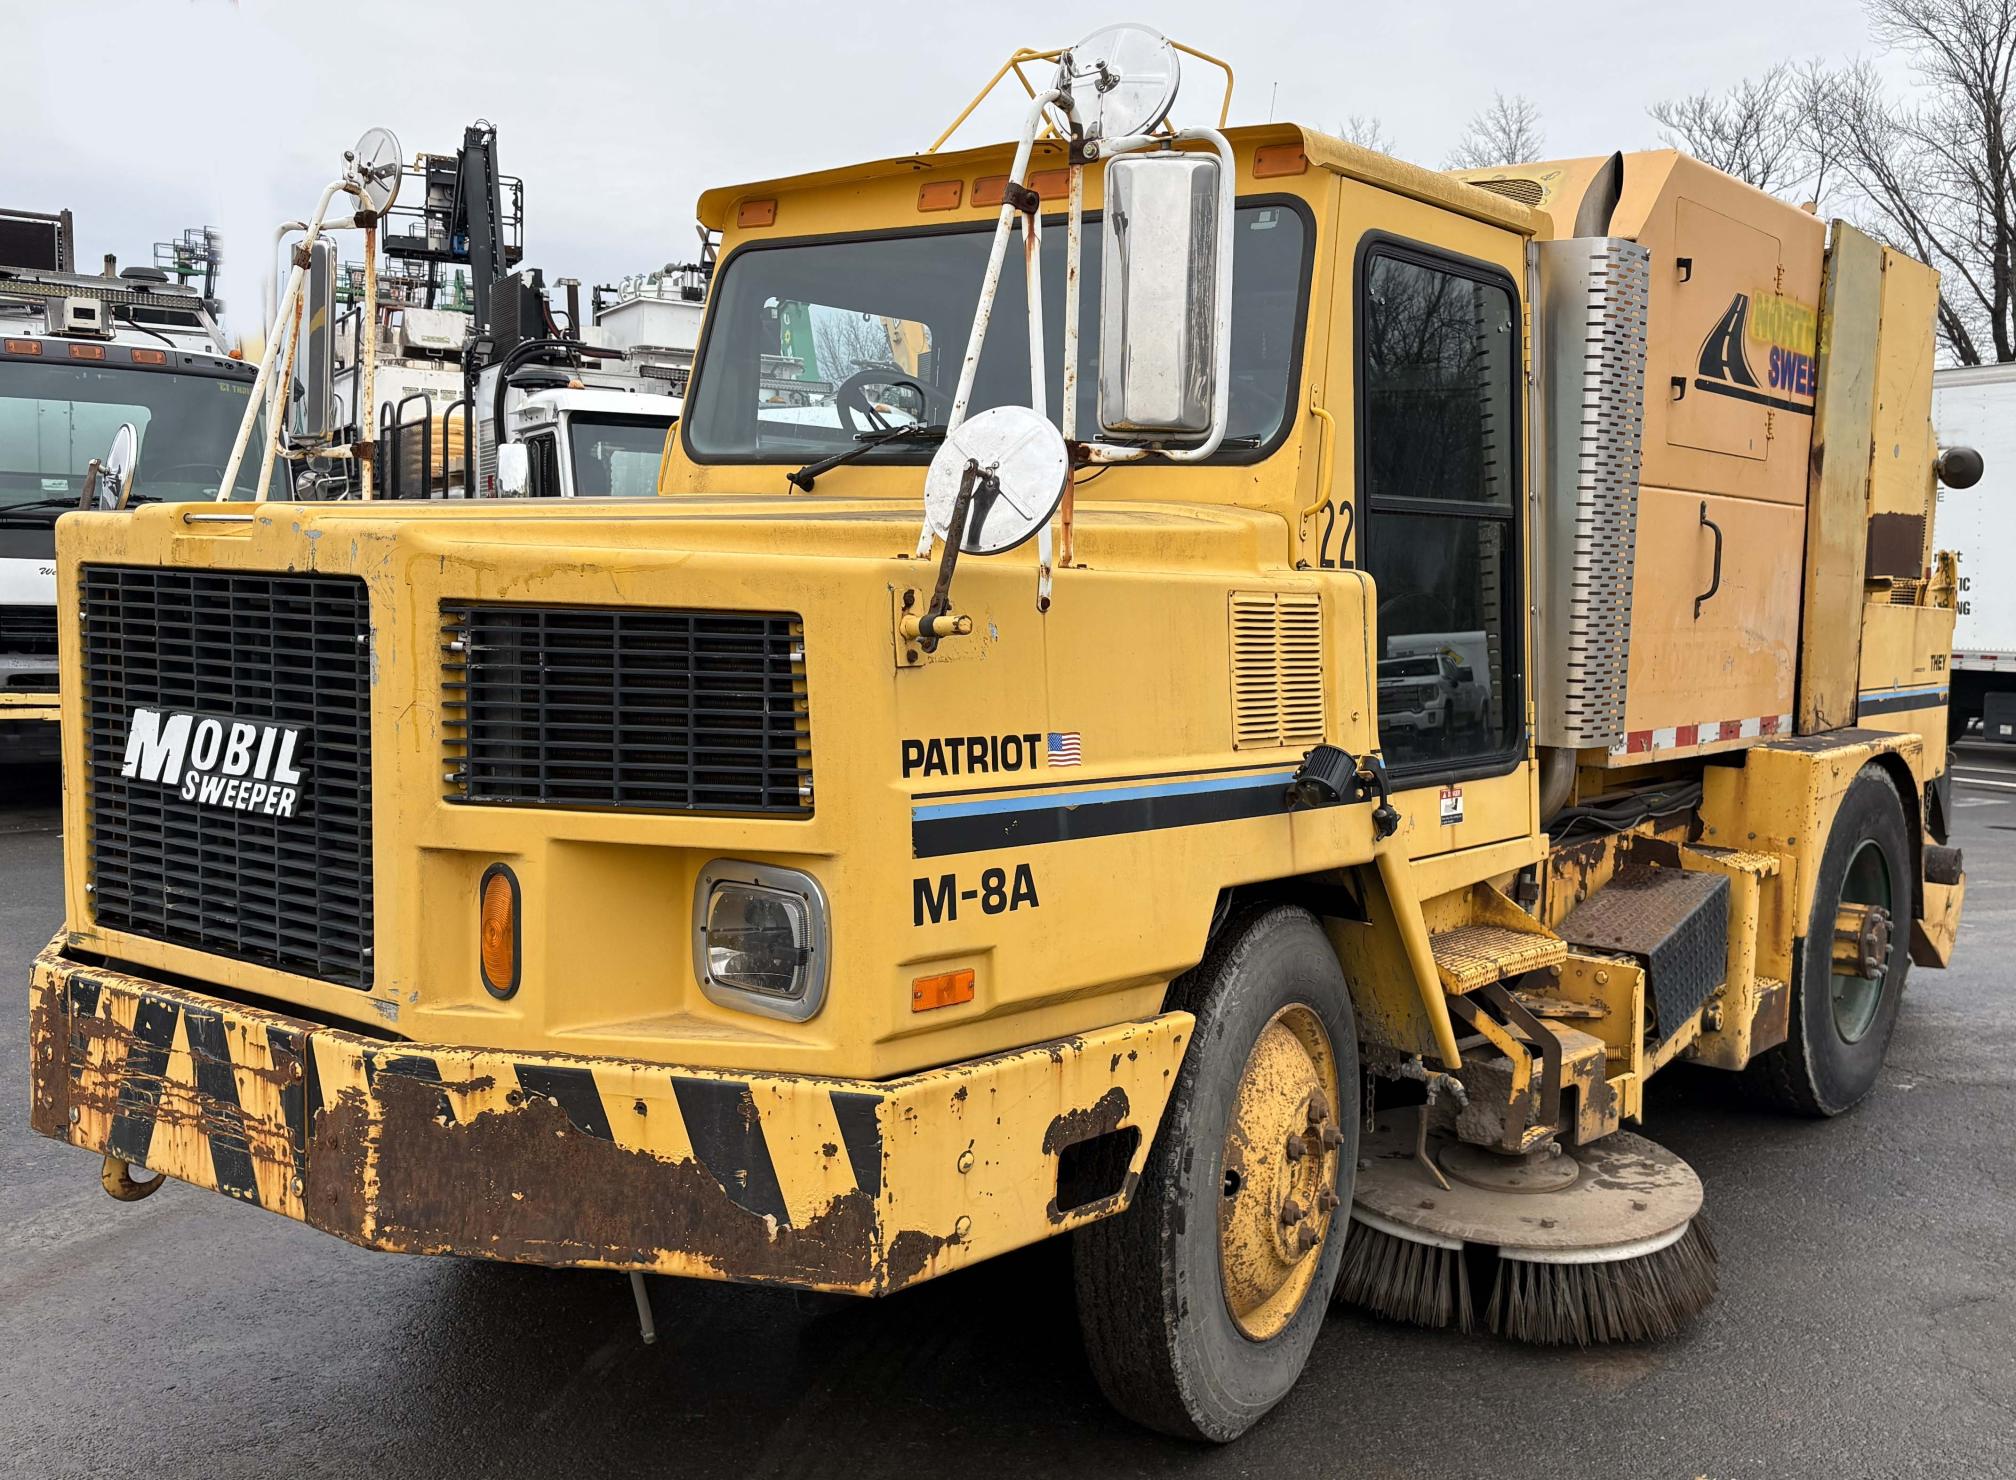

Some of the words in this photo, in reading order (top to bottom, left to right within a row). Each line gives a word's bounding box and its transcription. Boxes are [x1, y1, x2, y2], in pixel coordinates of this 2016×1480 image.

[1319, 498, 1354, 569] 22
[120, 708, 301, 785] MOBIL
[901, 733, 1042, 779] PATRIOT
[181, 770, 297, 818] SWEEPER
[912, 863, 1040, 927] M-8A
